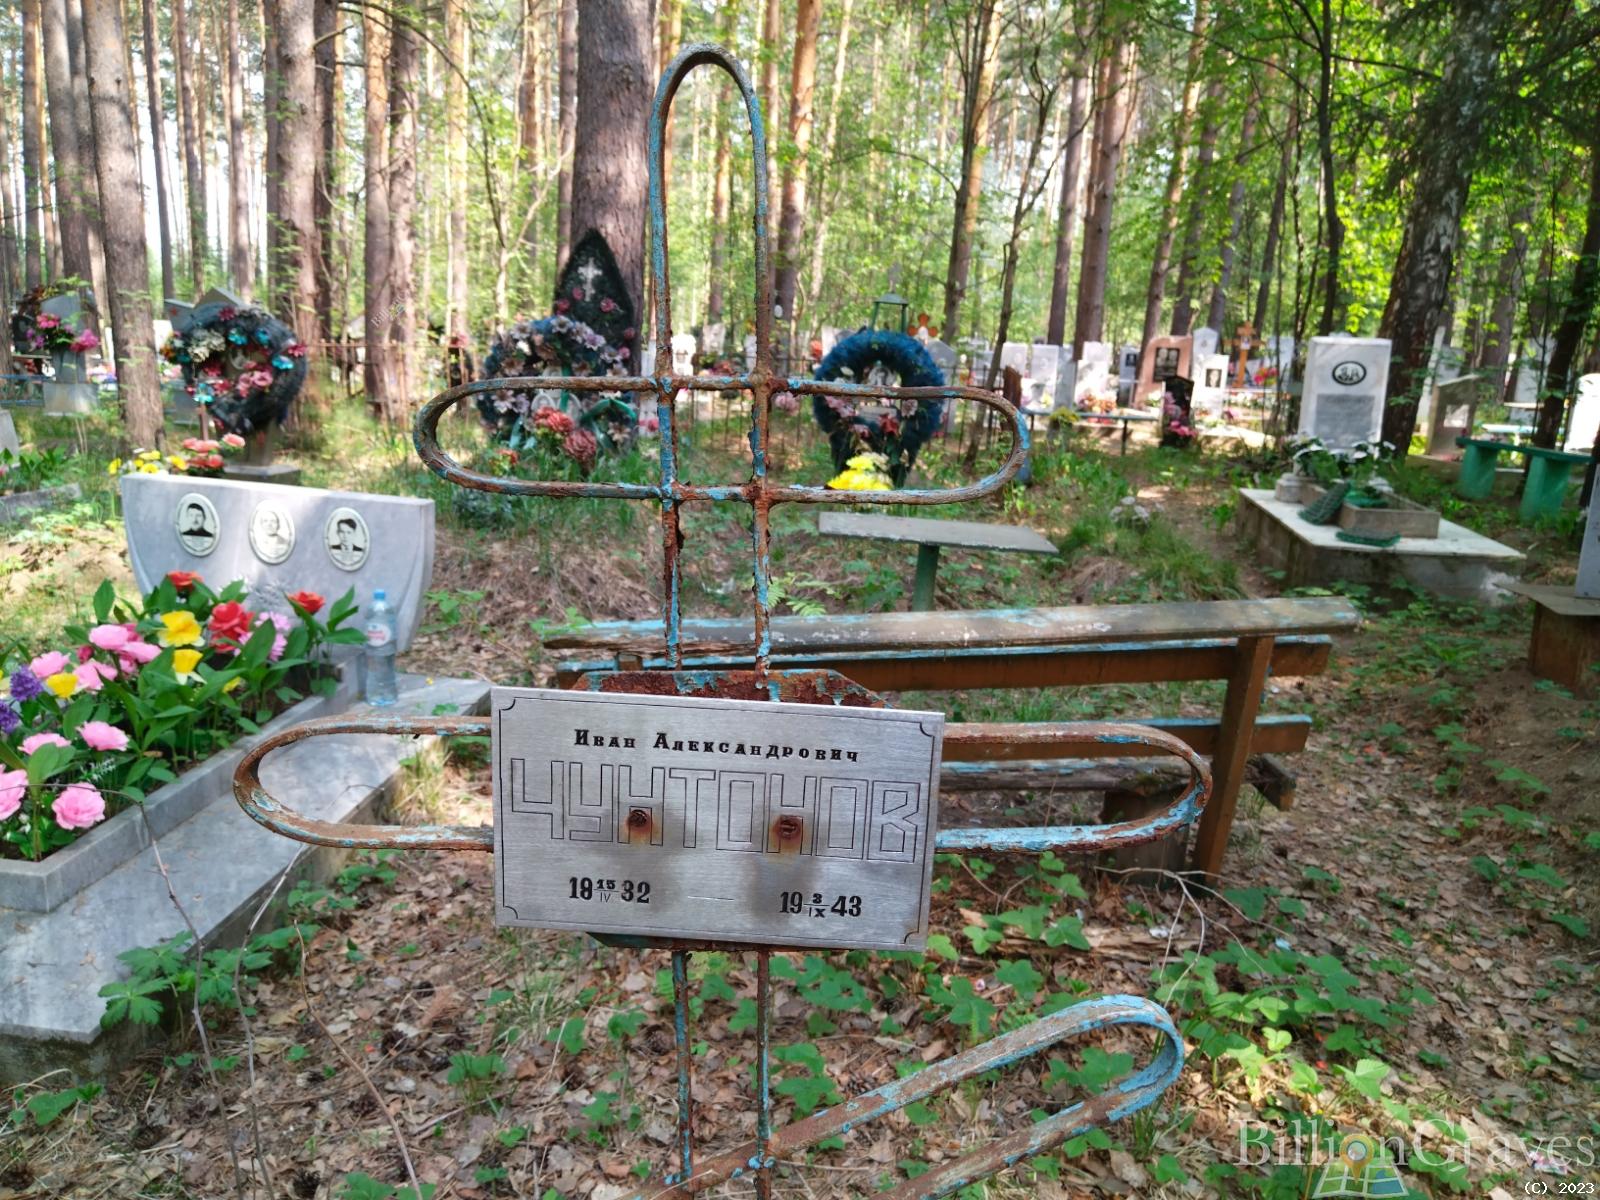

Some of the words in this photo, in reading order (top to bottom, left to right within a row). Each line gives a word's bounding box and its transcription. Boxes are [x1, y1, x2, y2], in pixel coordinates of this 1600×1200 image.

[574, 729, 635, 748] Иван
[653, 732, 858, 763] Александрович
[511, 758, 920, 864] ЧУНТОНОВ
